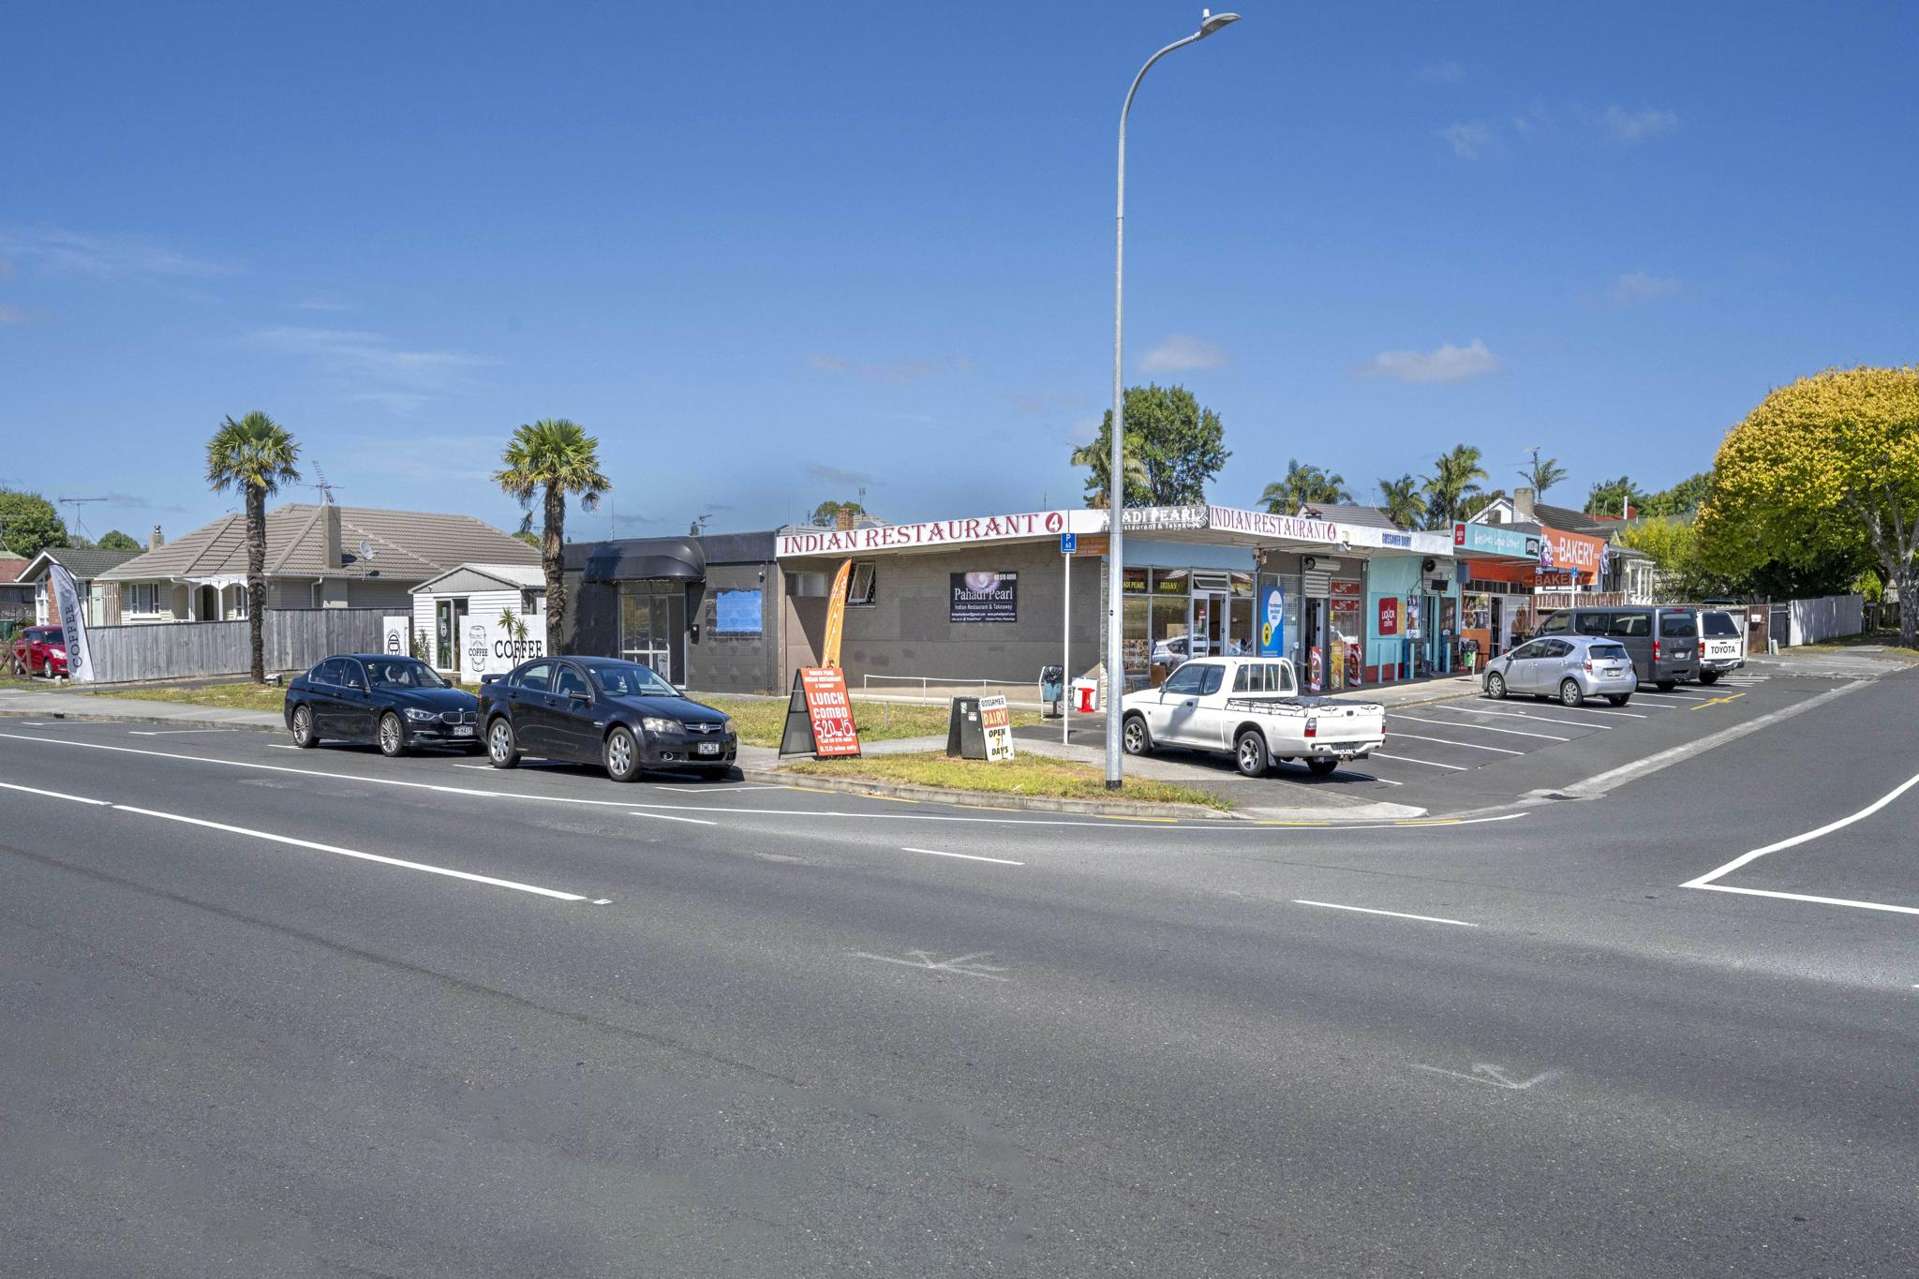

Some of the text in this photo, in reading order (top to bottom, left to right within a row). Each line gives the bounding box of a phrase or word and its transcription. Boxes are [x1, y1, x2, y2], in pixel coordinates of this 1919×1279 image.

[1151, 508, 1196, 522] PEARL
[1210, 511, 1251, 531] INDIAN
[1254, 516, 1327, 540] RESTAURANT
[784, 531, 857, 554] INDIAN
[865, 514, 1040, 548] RESTAURANT
[1560, 536, 1594, 567] BAKERY
[954, 586, 1013, 601] Pahadi Pearl
[65, 604, 82, 667] COFFEE
[468, 648, 488, 657] COFFEE
[494, 640, 543, 659] COFFEE
[1711, 646, 1735, 654] TOYOTA
[809, 692, 845, 705] LUNCH
[813, 707, 848, 719] COMBO
[984, 708, 1008, 725] DAIRY
[989, 728, 1006, 738] OPEN
[996, 738, 1000, 746] 7
[992, 746, 1009, 756] DAYS
